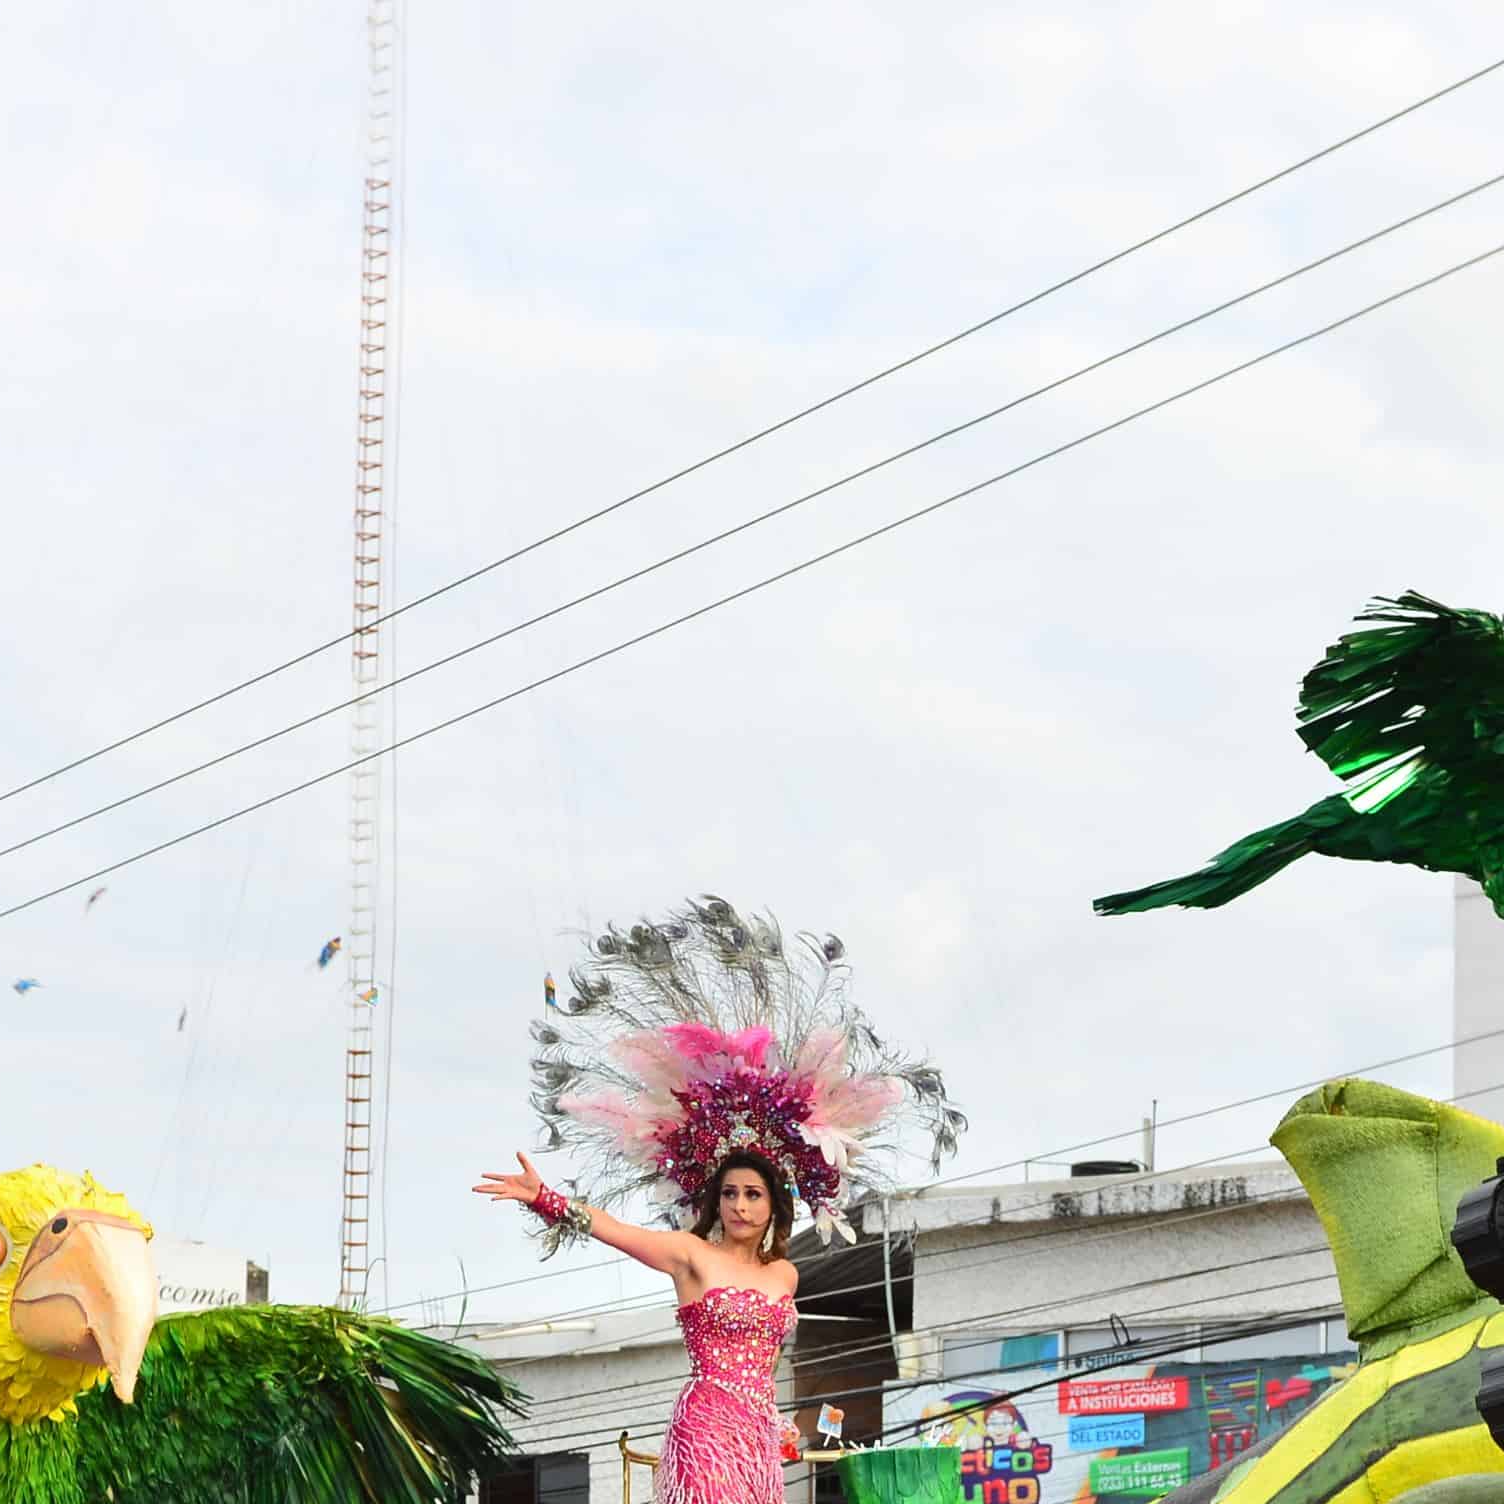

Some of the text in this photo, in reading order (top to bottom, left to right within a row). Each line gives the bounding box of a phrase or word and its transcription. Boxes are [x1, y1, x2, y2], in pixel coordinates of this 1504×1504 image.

[1067, 1391, 1177, 1411] A INSTITUCIONES
[1071, 1429, 1142, 1443] DEL ESTADO
